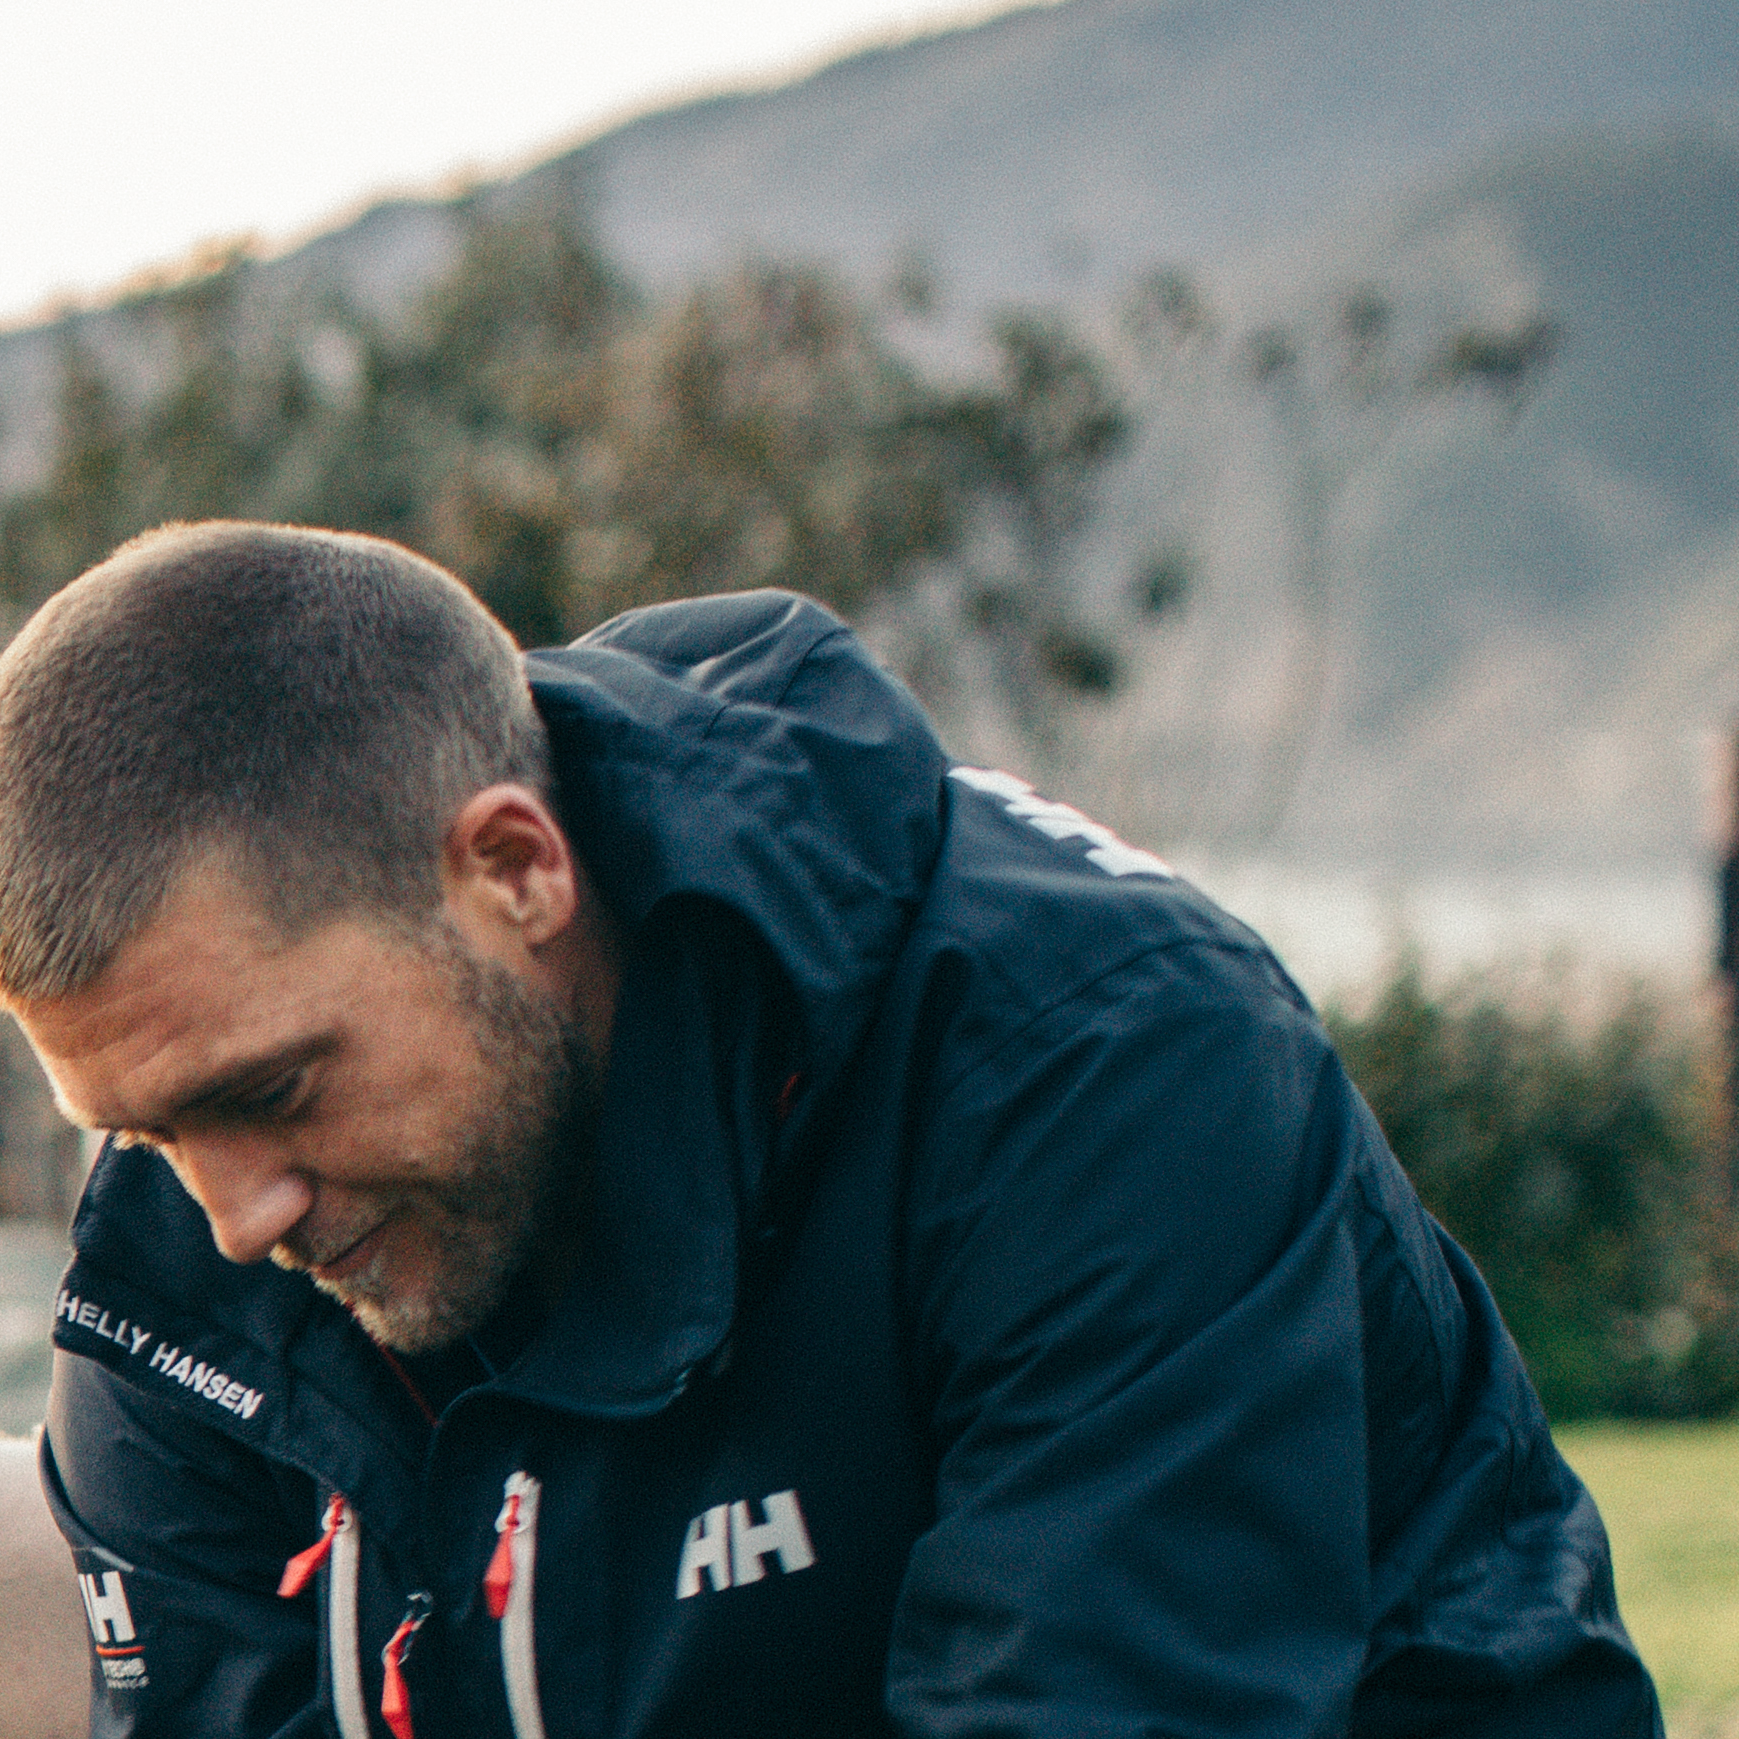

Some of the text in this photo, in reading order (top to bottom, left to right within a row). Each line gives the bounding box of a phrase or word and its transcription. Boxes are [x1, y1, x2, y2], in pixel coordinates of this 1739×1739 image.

[56, 1289, 264, 1419] HELLY HANSEN
[676, 1488, 816, 1600] HH
[78, 1571, 136, 1642] H
